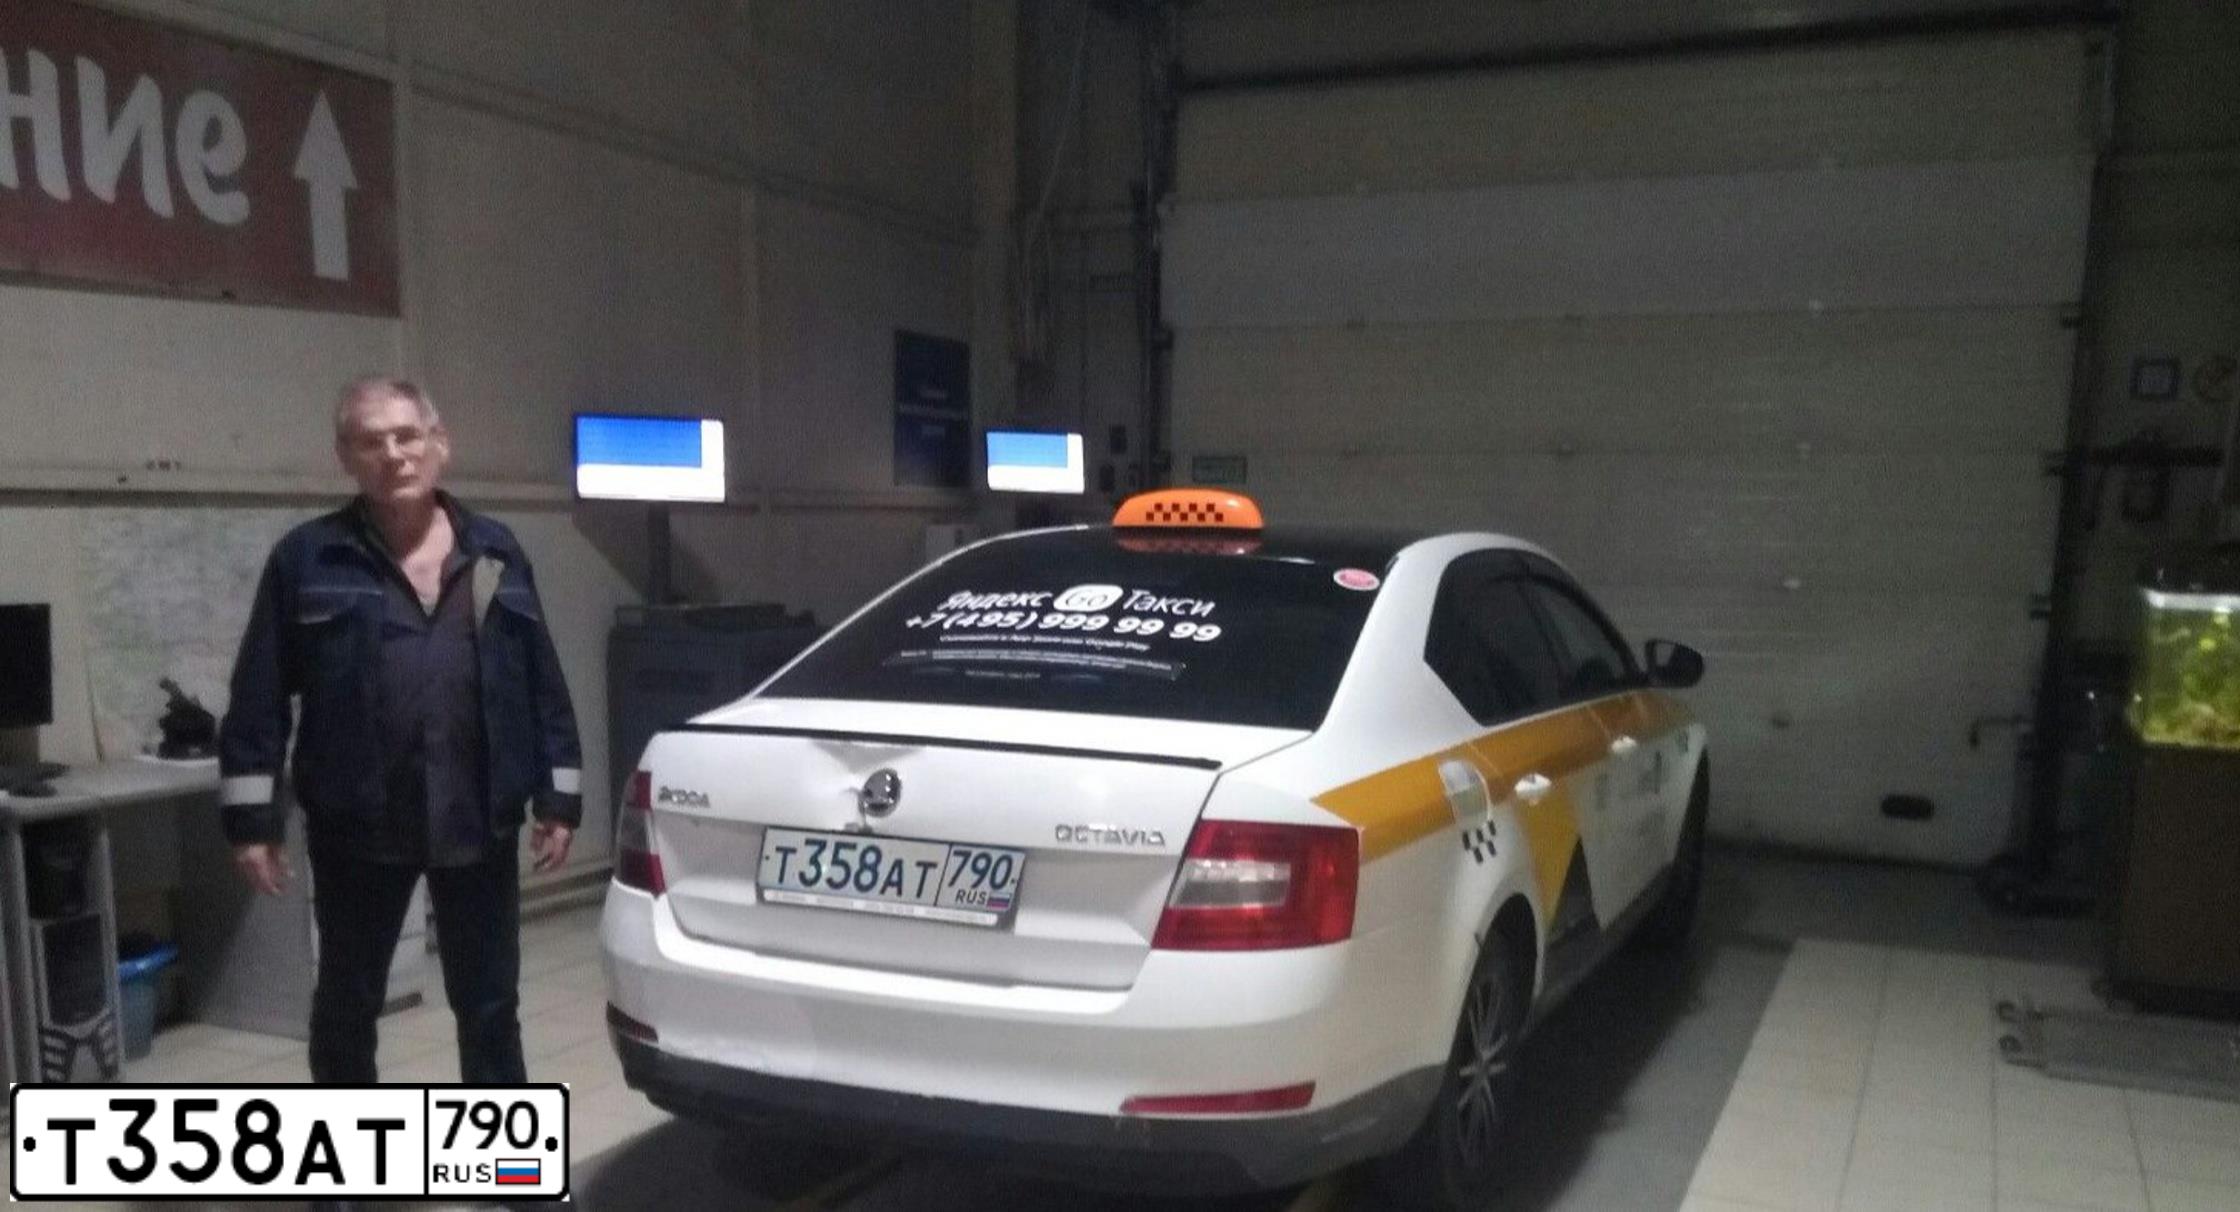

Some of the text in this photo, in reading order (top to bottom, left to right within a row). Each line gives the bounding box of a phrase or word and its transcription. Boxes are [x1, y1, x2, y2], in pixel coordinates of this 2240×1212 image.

[1123, 589, 1216, 618] Такси
[1038, 612, 1110, 631] 999
[1113, 616, 1165, 636] 99
[1169, 621, 1222, 642] 99
[1055, 823, 1166, 846] OCTAVIA
[948, 850, 1013, 890] 790
[956, 889, 987, 904] RUS
